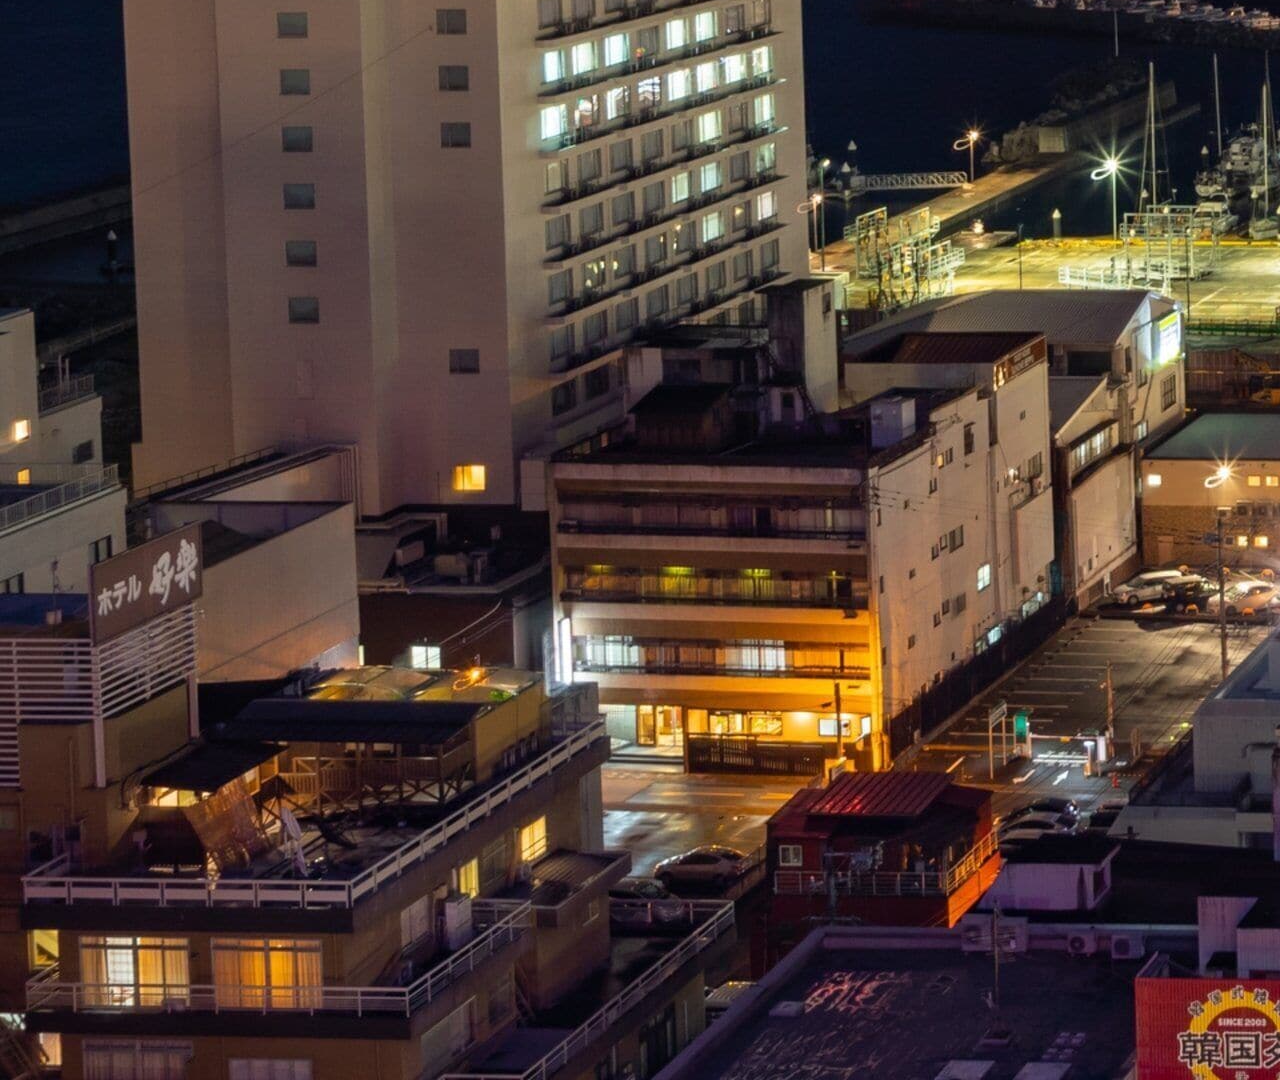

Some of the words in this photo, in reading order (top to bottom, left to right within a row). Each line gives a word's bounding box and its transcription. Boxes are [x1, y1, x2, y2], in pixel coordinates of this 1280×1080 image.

[97, 574, 142, 617] ホテル
[1218, 1018, 1243, 1026] SINCE
